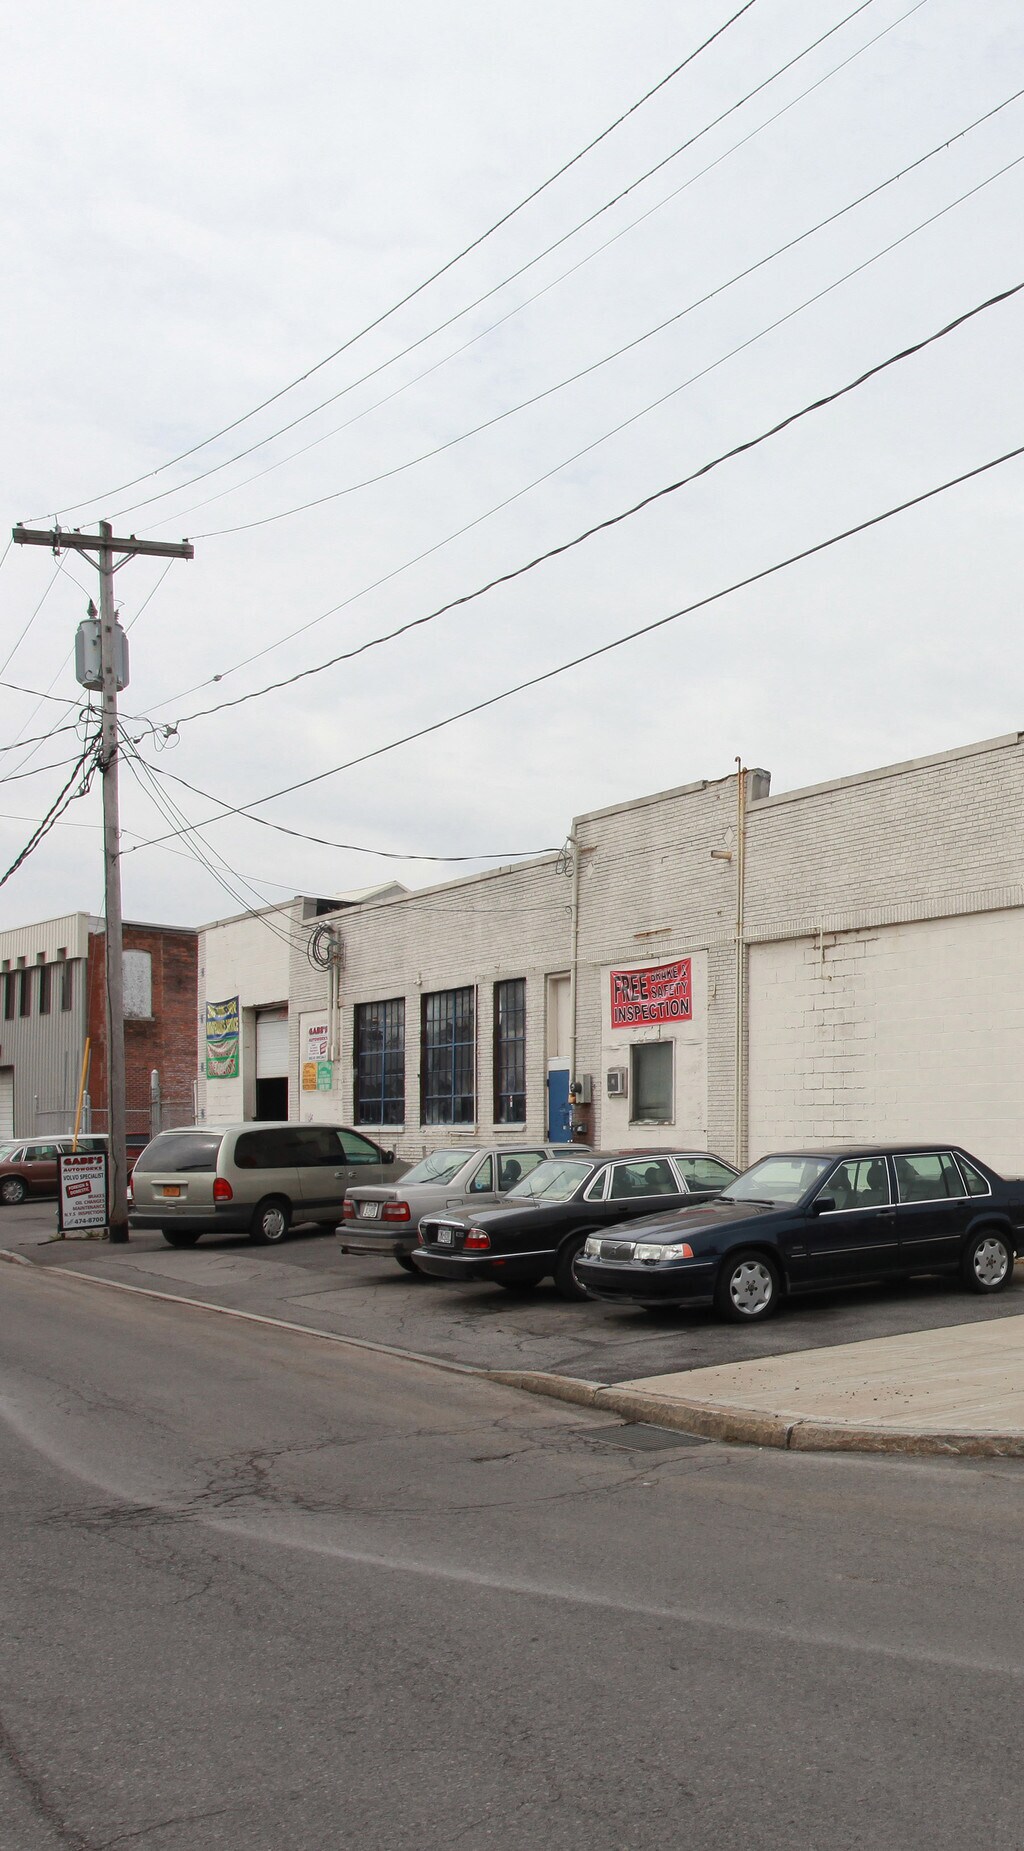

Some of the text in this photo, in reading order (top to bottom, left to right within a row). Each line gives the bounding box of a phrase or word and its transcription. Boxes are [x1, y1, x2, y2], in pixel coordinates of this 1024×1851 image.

[614, 974, 649, 1004] FREE
[650, 966, 679, 982] BRAKE
[650, 981, 688, 998] SAFETY
[614, 998, 689, 1023] INSPECTION
[64, 1156, 103, 1165] GABE'S
